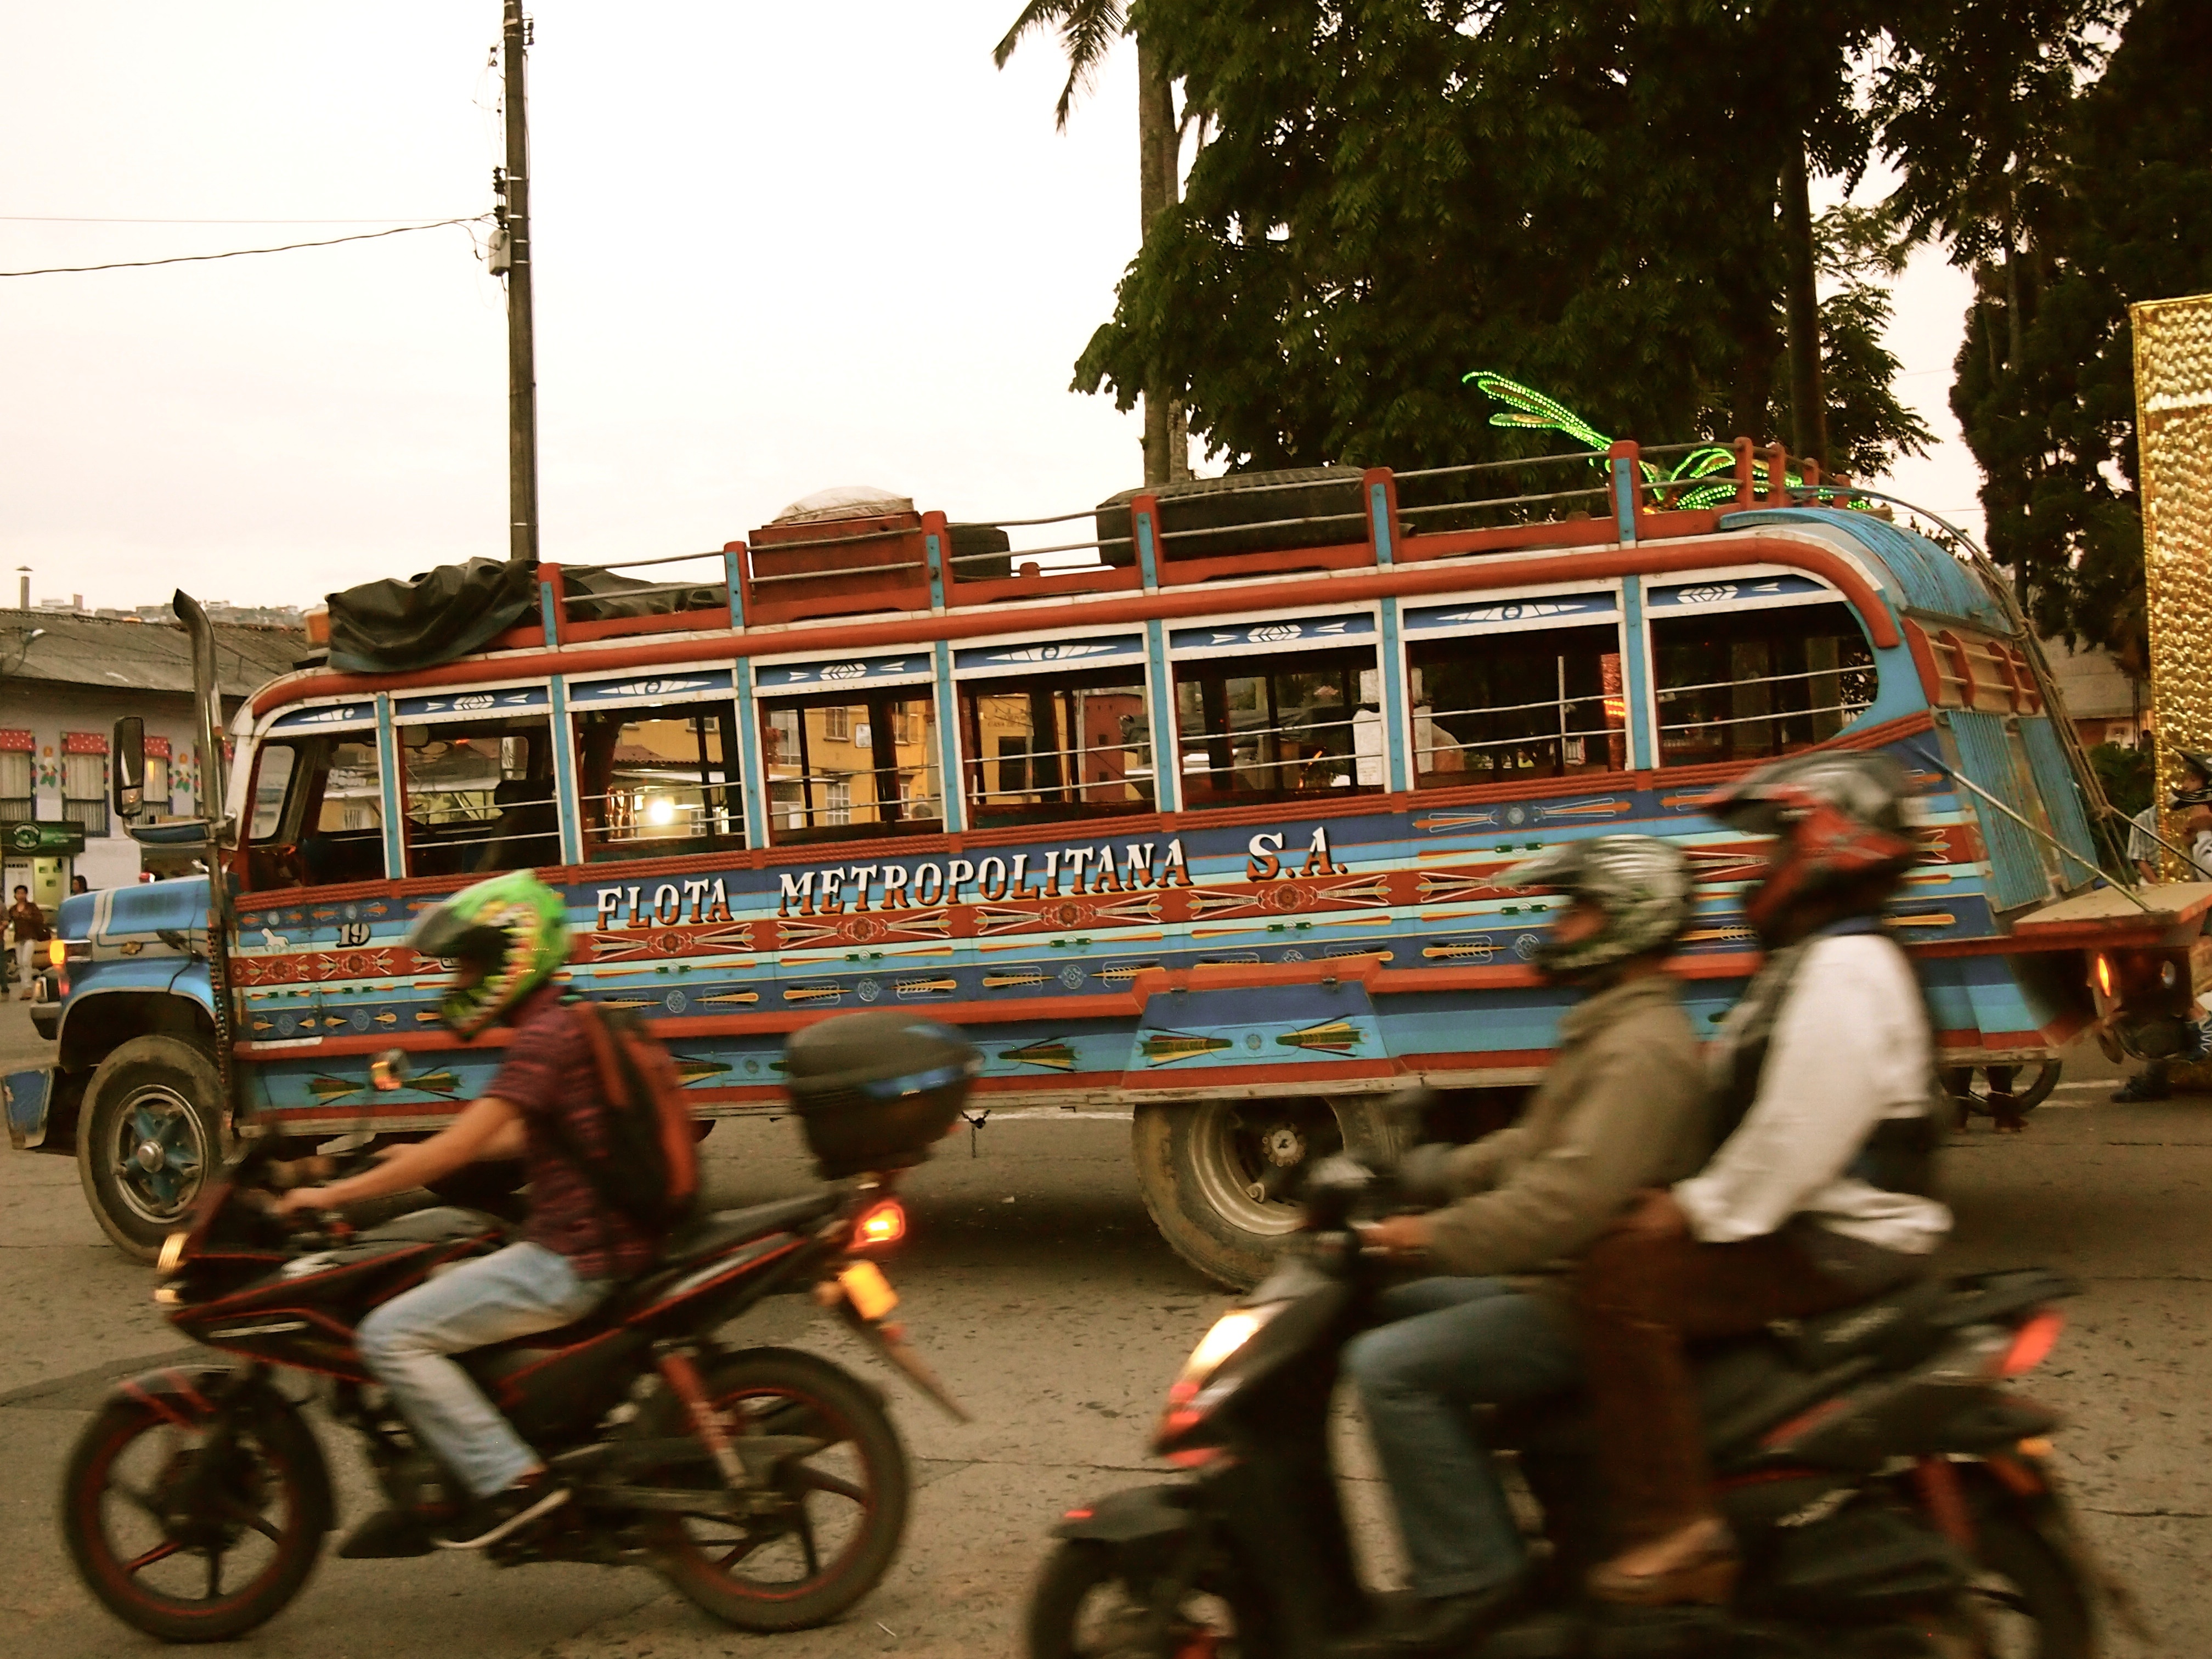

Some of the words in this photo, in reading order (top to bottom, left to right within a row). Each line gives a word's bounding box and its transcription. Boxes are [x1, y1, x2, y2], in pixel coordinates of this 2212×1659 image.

[596, 877, 735, 930] FLOTA
[777, 838, 1194, 917] METROPOLITANA
[1246, 826, 1348, 882] S.A.
[336, 923, 371, 947] 19
